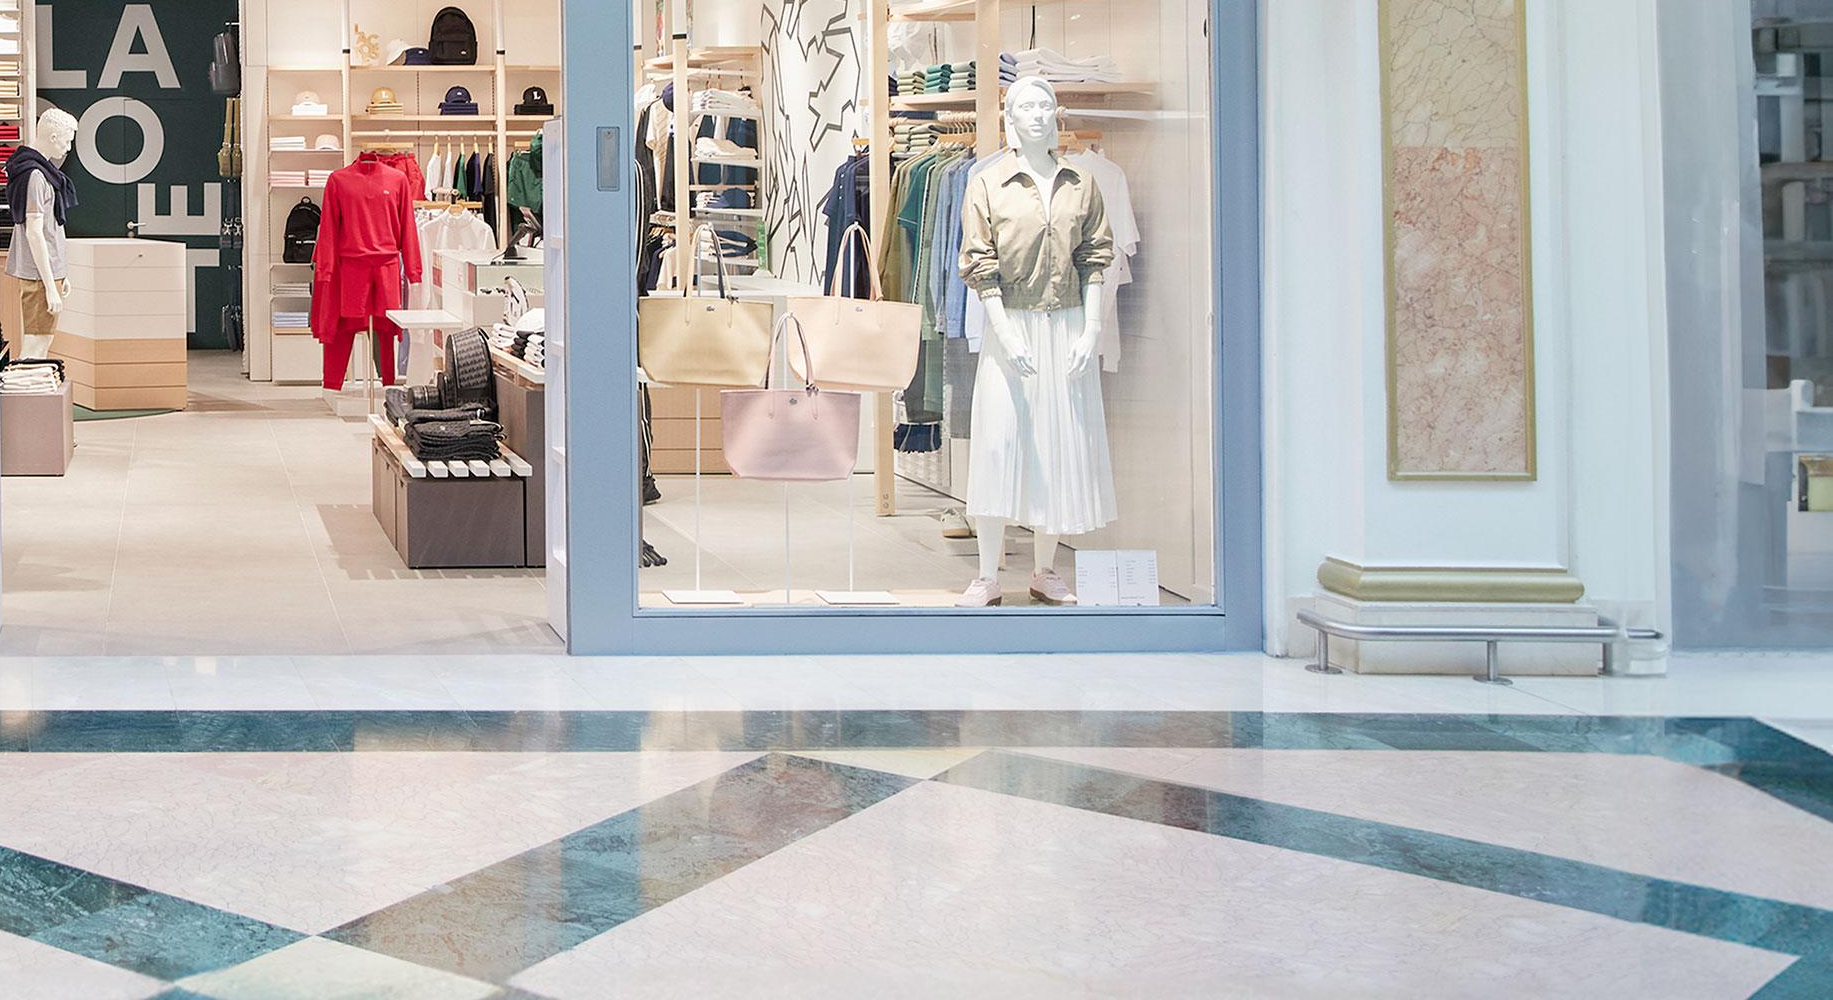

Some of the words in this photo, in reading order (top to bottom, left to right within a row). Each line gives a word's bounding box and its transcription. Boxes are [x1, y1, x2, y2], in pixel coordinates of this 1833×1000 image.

[36, 3, 182, 89] LA
[533, 91, 541, 100] L
[36, 96, 165, 185] O
